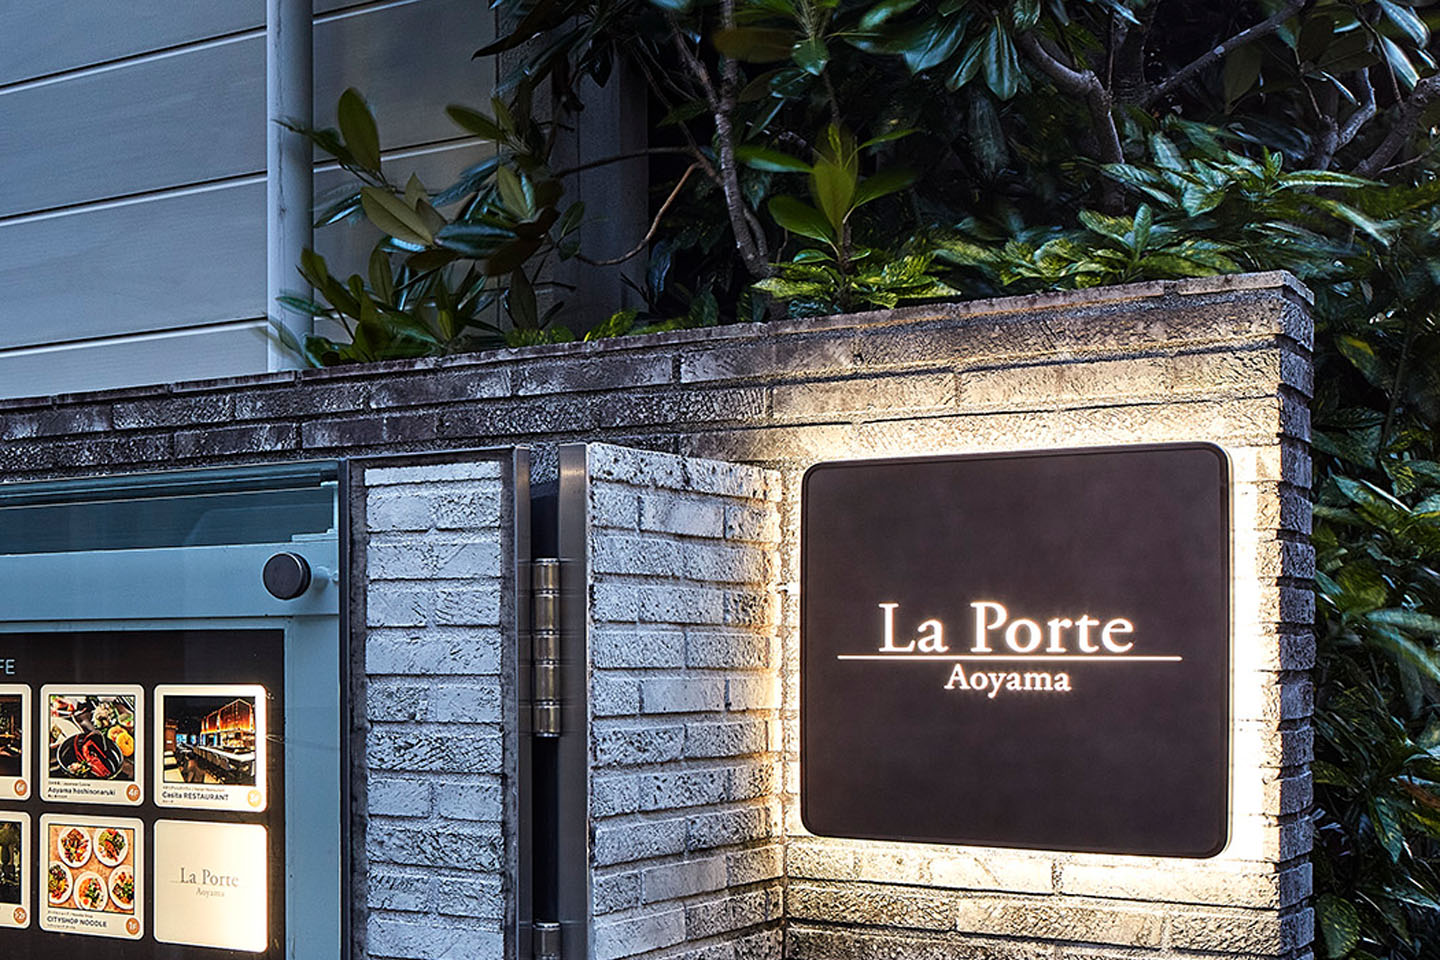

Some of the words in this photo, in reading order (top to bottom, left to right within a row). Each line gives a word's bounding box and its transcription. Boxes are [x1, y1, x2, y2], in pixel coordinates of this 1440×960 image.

[877, 602, 949, 654] La
[970, 601, 1135, 655] Porte
[944, 663, 1072, 699] Aoyama
[47, 786, 72, 796] Aoyama
[183, 791, 229, 801] RESTAURANT
[180, 867, 197, 884] La
[202, 869, 239, 887] Porte
[47, 915, 79, 925] CITYSHOP
[79, 918, 107, 928] NOODLE
